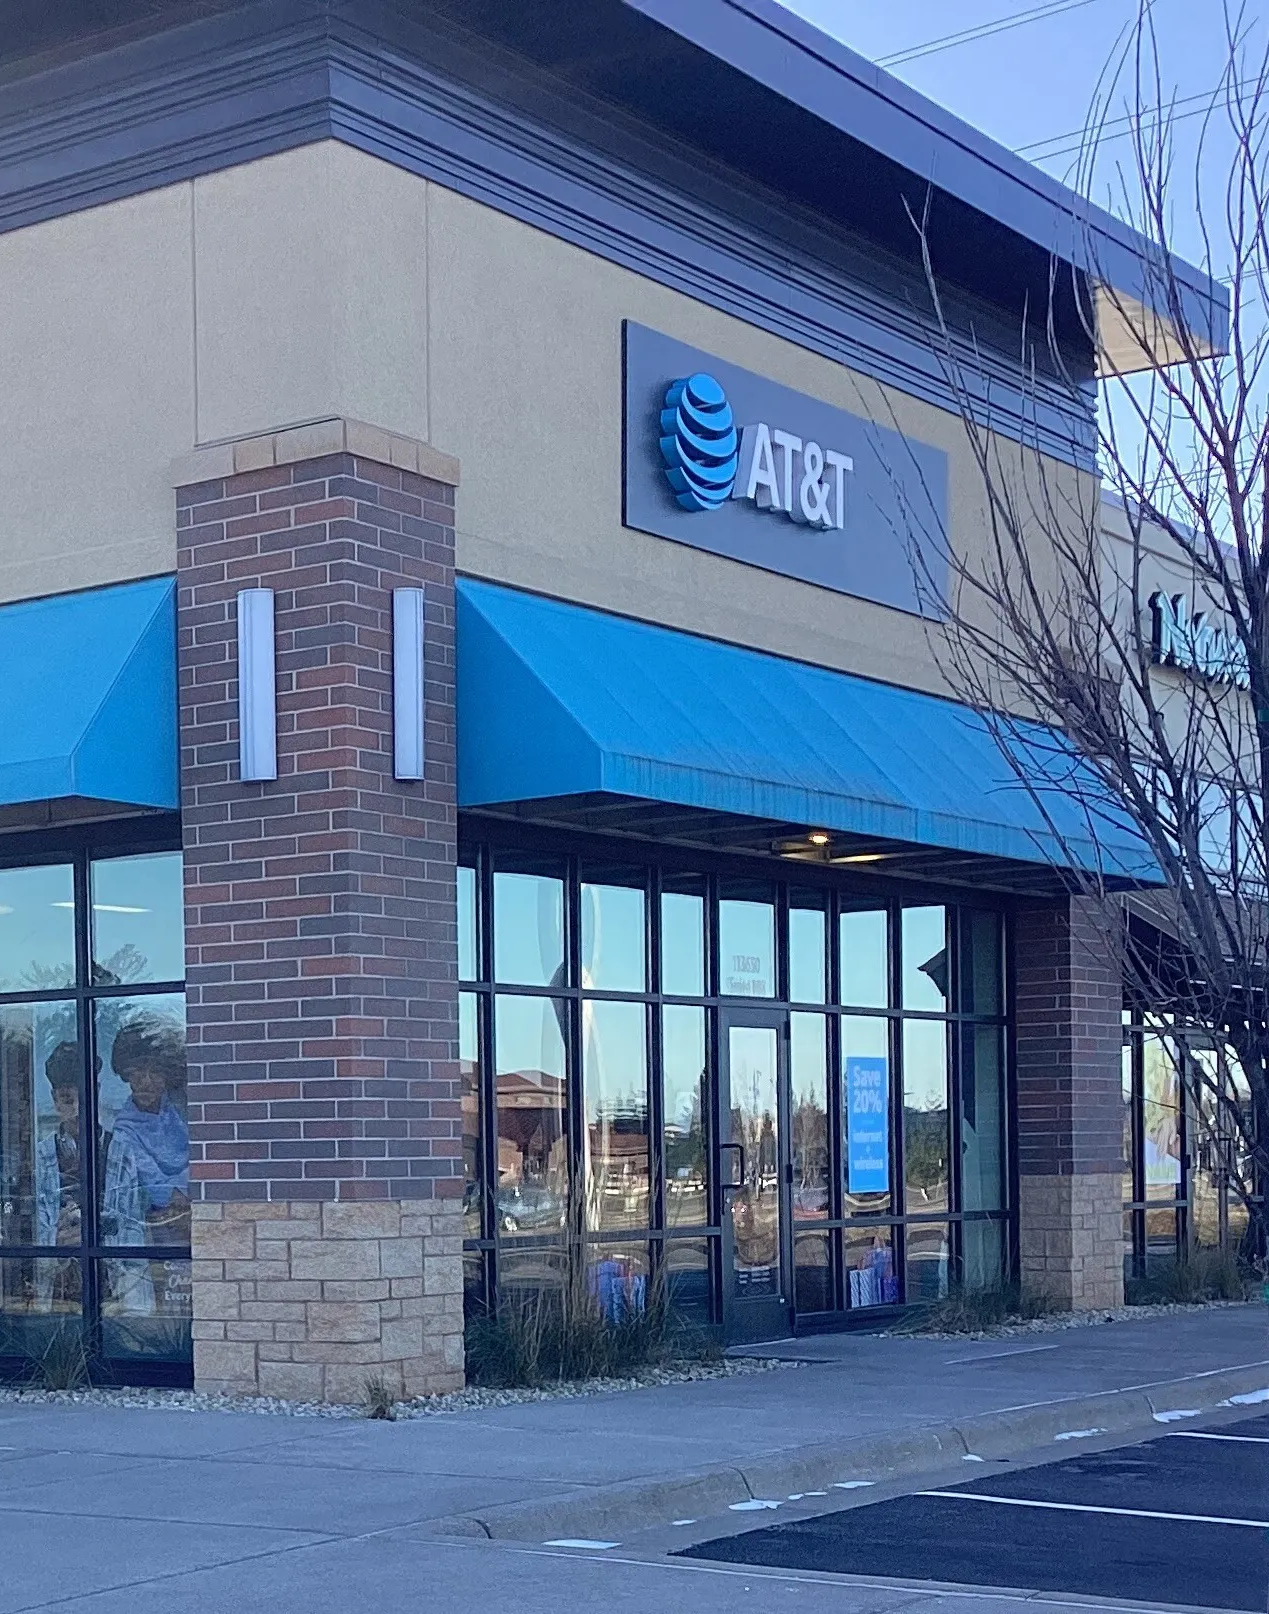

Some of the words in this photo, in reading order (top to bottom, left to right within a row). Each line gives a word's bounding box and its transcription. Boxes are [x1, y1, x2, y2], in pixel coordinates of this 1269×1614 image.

[732, 422, 854, 531] AT&T
[853, 1065, 881, 1087] Save
[853, 1089, 882, 1113] 20%
